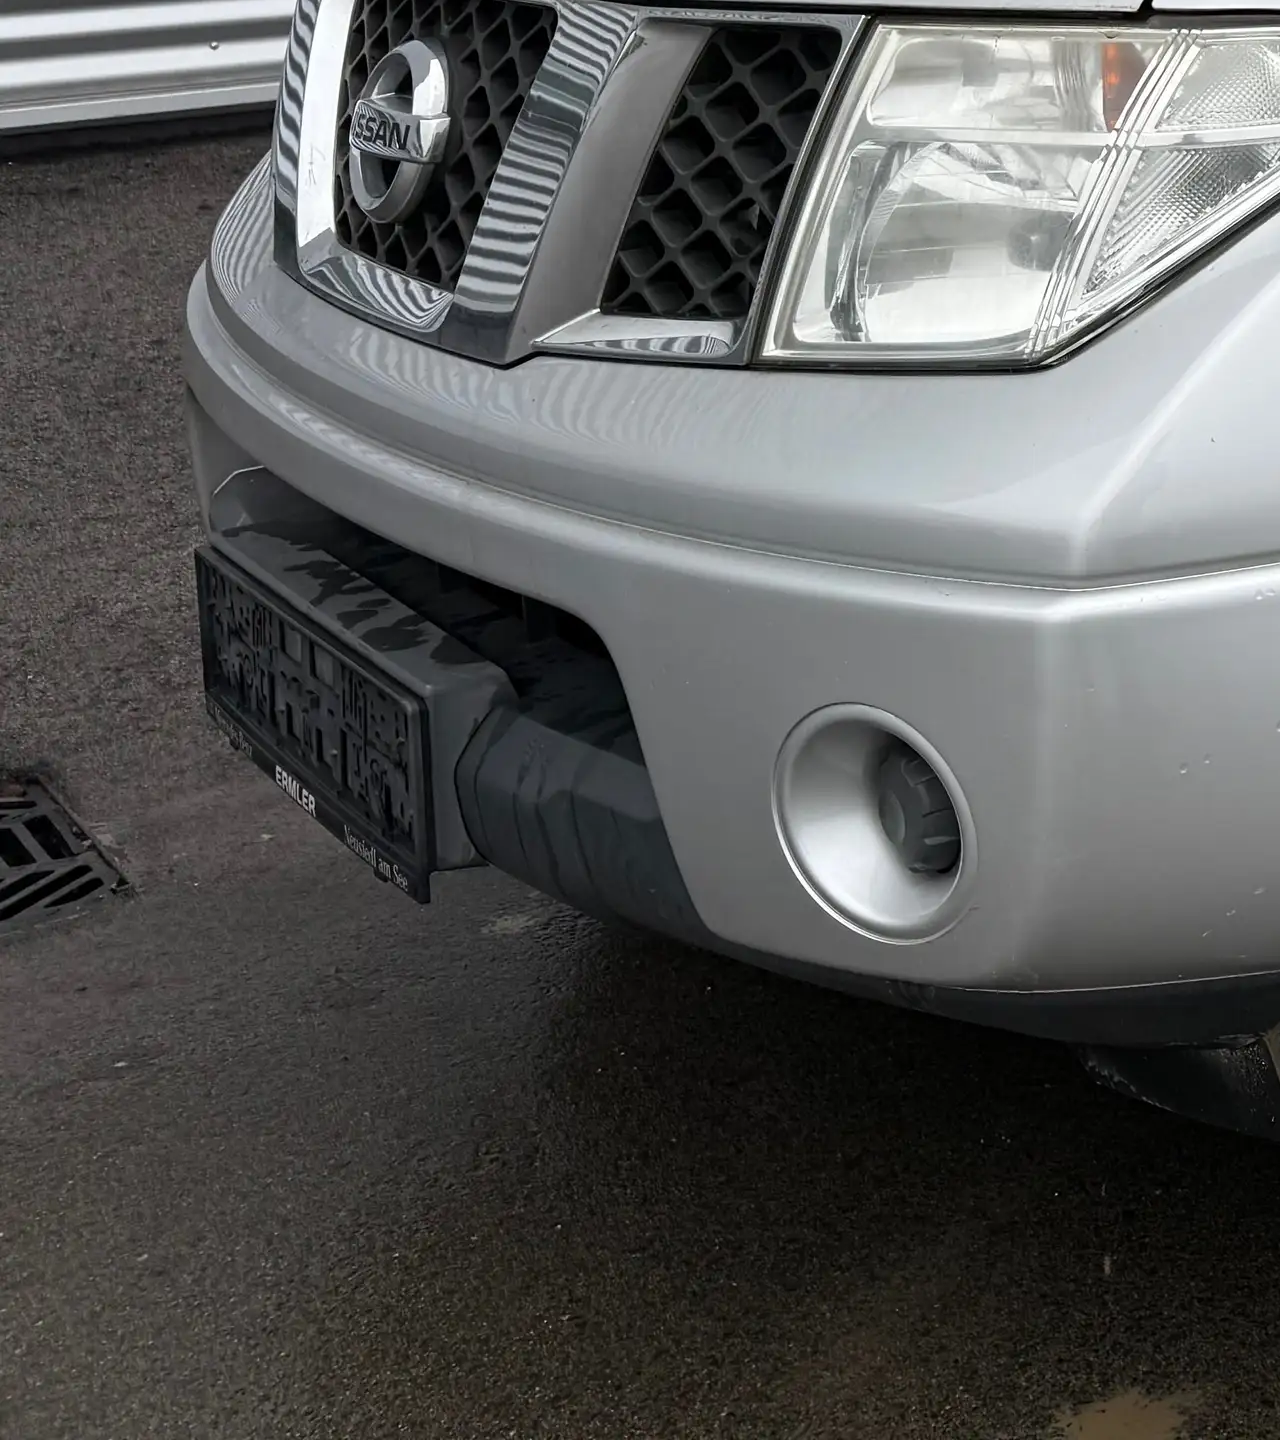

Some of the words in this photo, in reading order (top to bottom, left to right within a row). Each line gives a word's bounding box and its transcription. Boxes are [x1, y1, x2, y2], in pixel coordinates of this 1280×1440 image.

[354, 113, 411, 151] SSAN
[275, 764, 316, 818] ERMLER
[343, 824, 377, 868] Neusiedl
[378, 858, 391, 878] am
[392, 864, 409, 892] See
